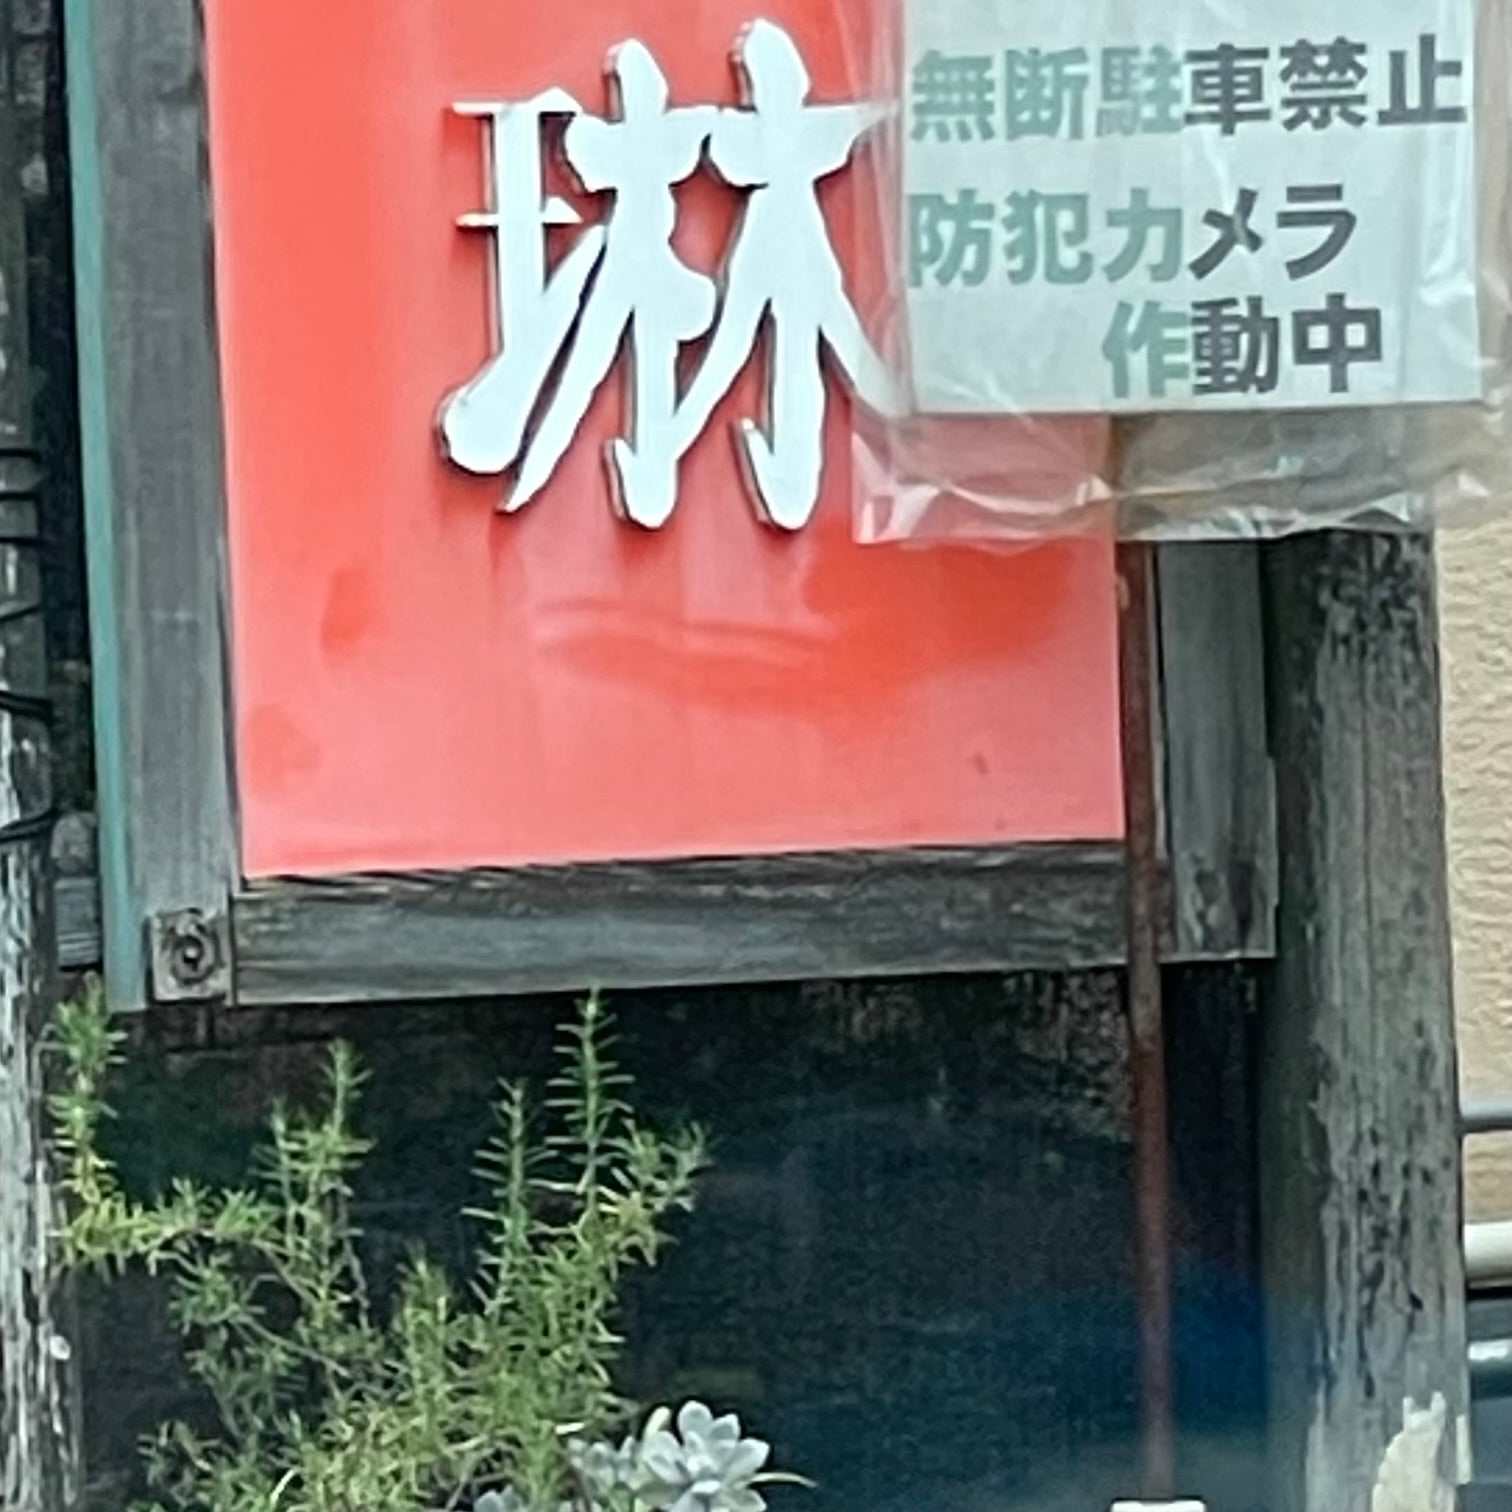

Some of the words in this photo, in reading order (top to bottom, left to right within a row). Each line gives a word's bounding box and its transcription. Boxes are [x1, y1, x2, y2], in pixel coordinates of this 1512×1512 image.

[910, 33, 1467, 142] 無断駐車禁止
[434, 18, 904, 530] 琳
[907, 184, 1358, 287] 防犯カメラ
[1101, 293, 1383, 398] 作動中
